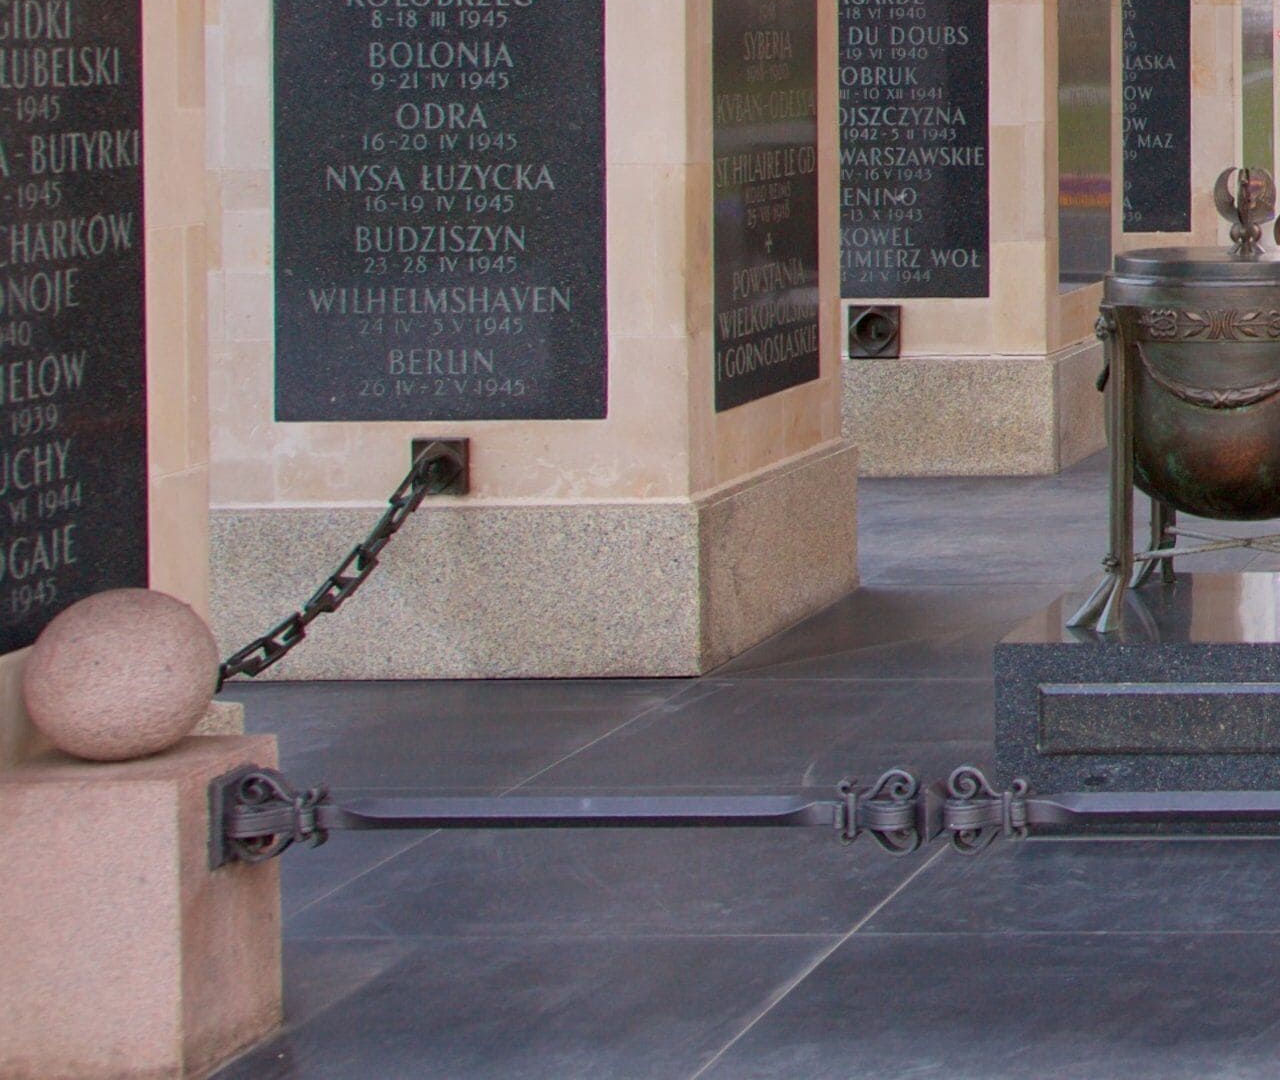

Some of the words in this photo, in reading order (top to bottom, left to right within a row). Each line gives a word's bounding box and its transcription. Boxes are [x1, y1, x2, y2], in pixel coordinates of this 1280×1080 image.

[460, 11, 508, 29] 1945
[890, 7, 926, 20] 1940
[849, 26, 879, 45] DU
[891, 26, 968, 45] DOUBS
[369, 42, 514, 68] BOLONIA
[891, 48, 927, 60] 1940
[461, 73, 509, 90] 1945
[396, 103, 487, 129] ODRA
[469, 133, 517, 150] 1945
[923, 128, 956, 141] 1943
[32, 129, 139, 174] BUTYRKI
[839, 147, 984, 166] WARSZAWSKIE
[326, 165, 405, 191] NYSA
[466, 195, 514, 212] 1945
[356, 226, 525, 253] BUDZISZYN
[469, 257, 517, 273] 1945
[309, 288, 572, 314] WILHELMSHAVEN
[475, 318, 524, 335] 1945
[389, 349, 494, 374] BERLIN
[477, 380, 524, 396] 1945
